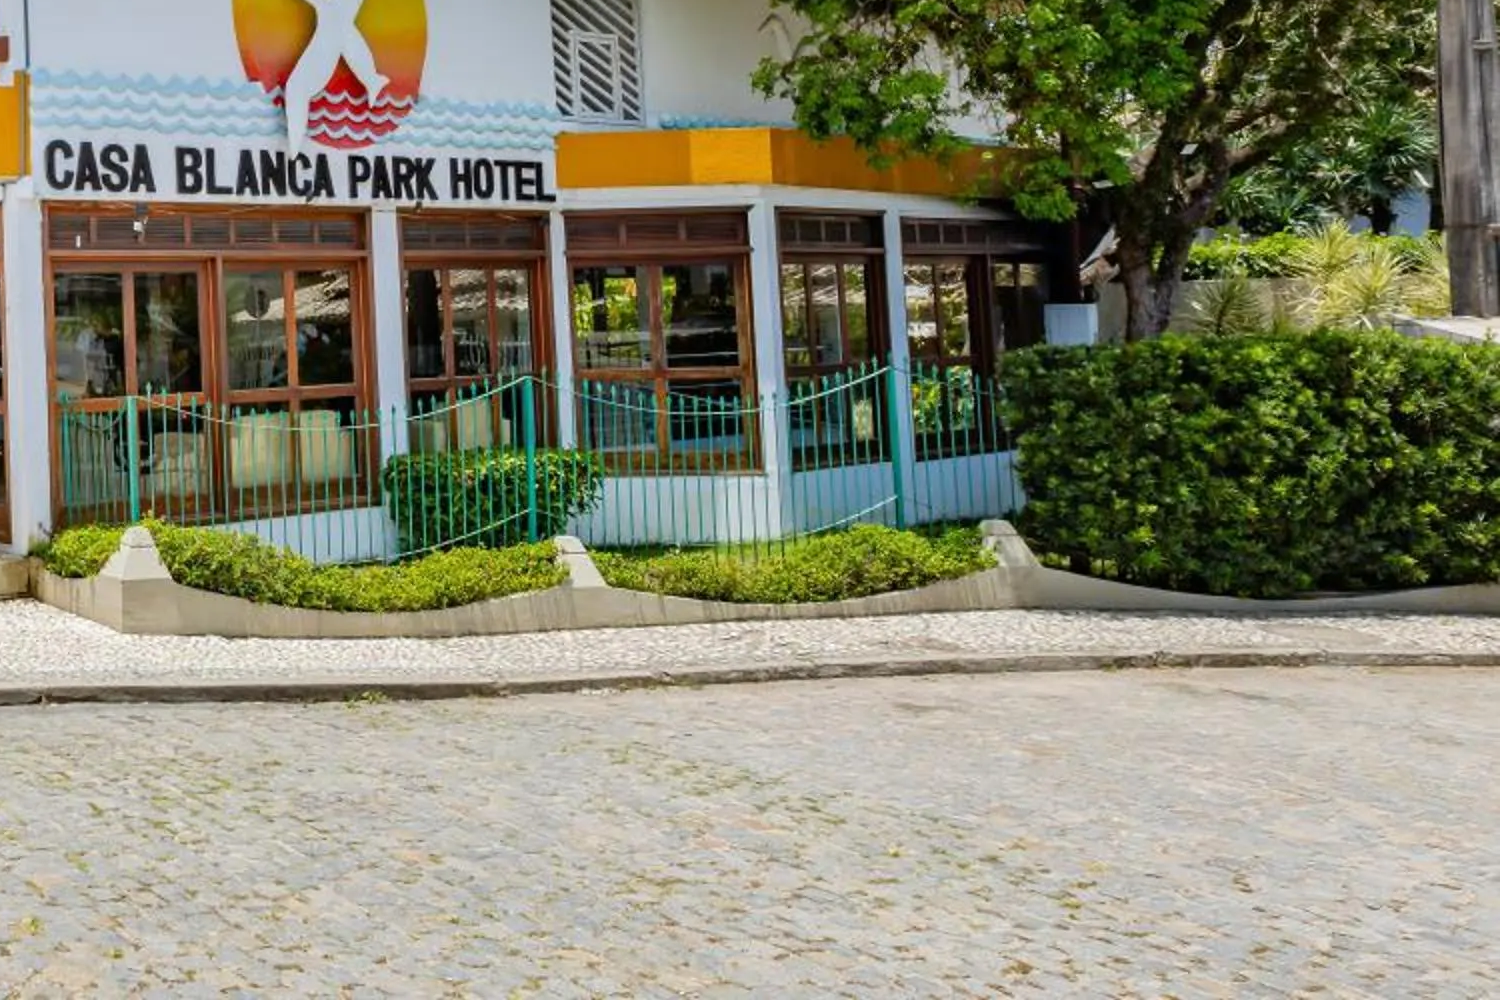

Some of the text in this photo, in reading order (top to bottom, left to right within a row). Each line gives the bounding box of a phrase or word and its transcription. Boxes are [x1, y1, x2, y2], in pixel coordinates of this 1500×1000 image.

[44, 138, 157, 192] CASA
[347, 155, 439, 201] PARK
[449, 157, 557, 203] HOTEL
